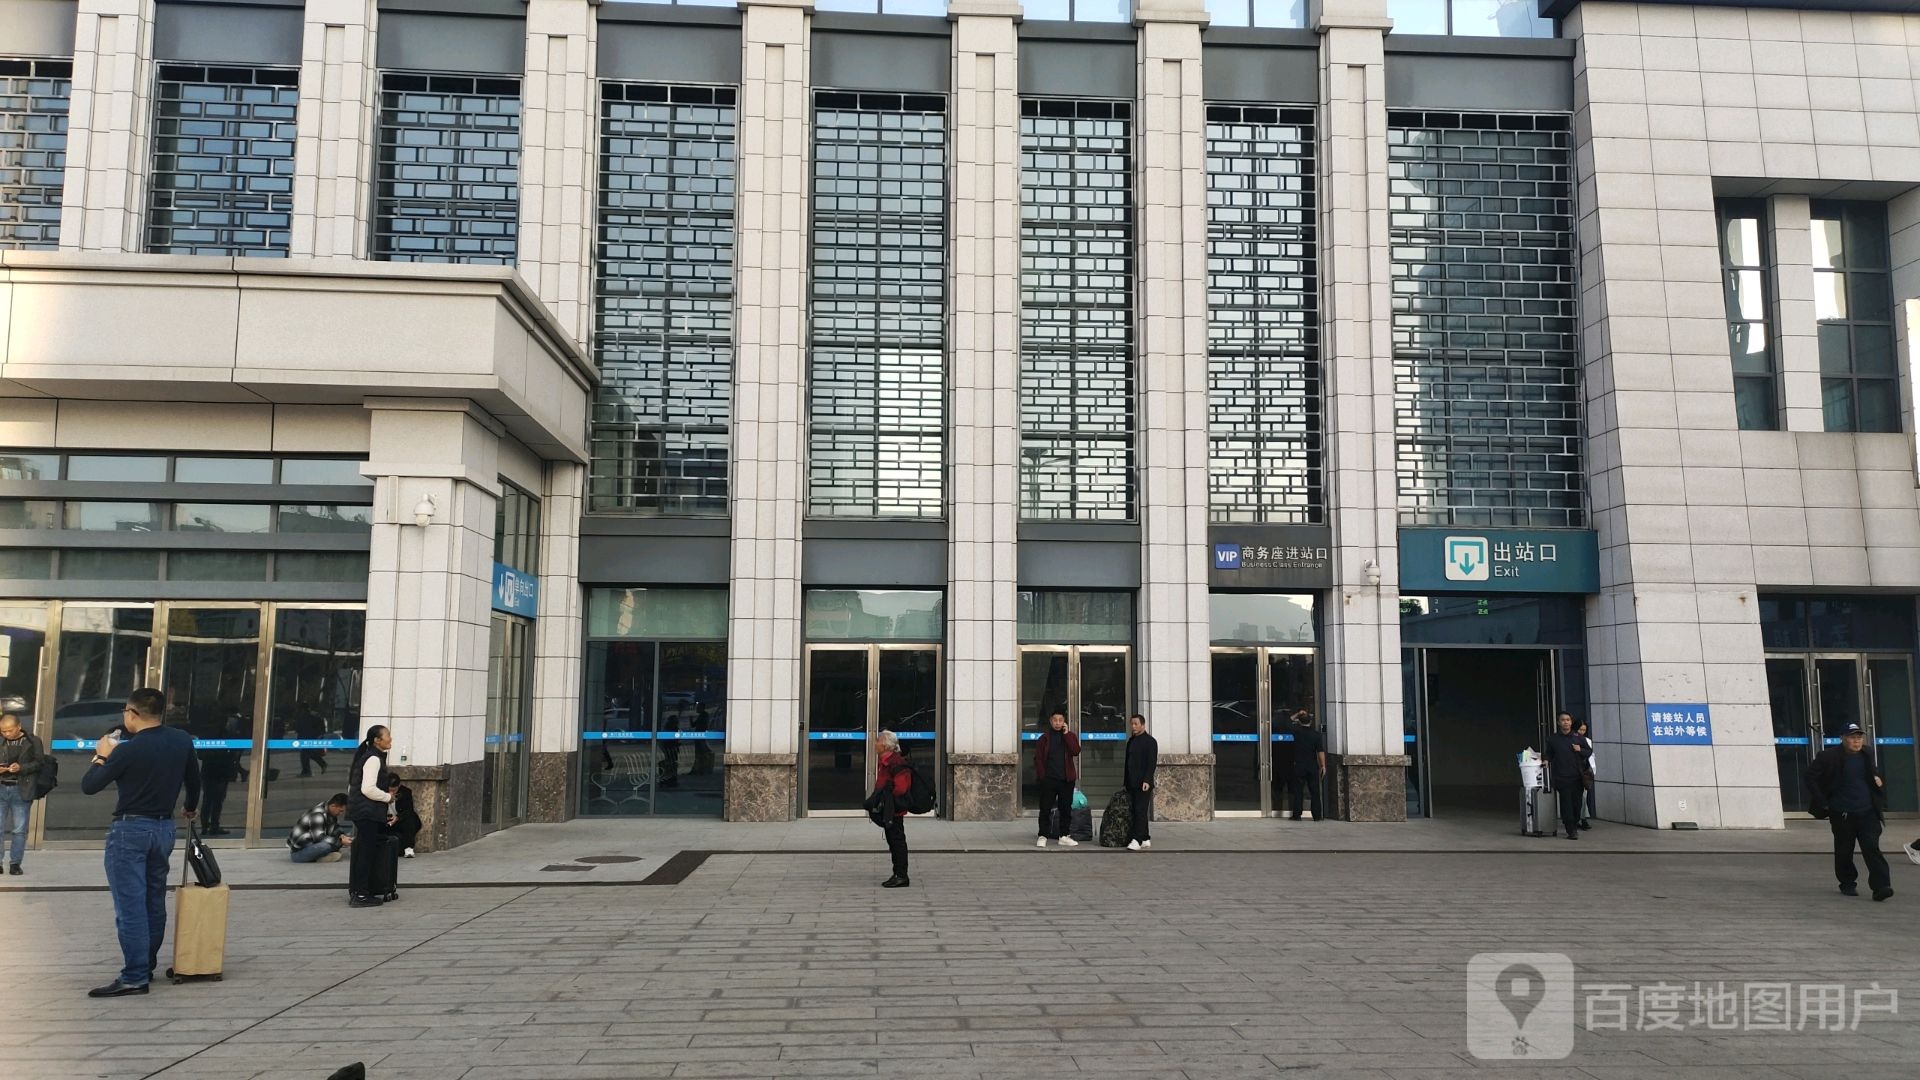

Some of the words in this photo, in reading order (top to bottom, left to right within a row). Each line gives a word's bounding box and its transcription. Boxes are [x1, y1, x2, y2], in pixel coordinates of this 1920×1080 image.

[1217, 551, 1238, 562] VIP
[1241, 546, 1328, 560] 商务座进站口
[1494, 541, 1557, 562] 出站口
[1494, 566, 1520, 577] Exit
[1651, 712, 1705, 723] 请接站人员
[1653, 726, 1707, 736] 在站外等候
